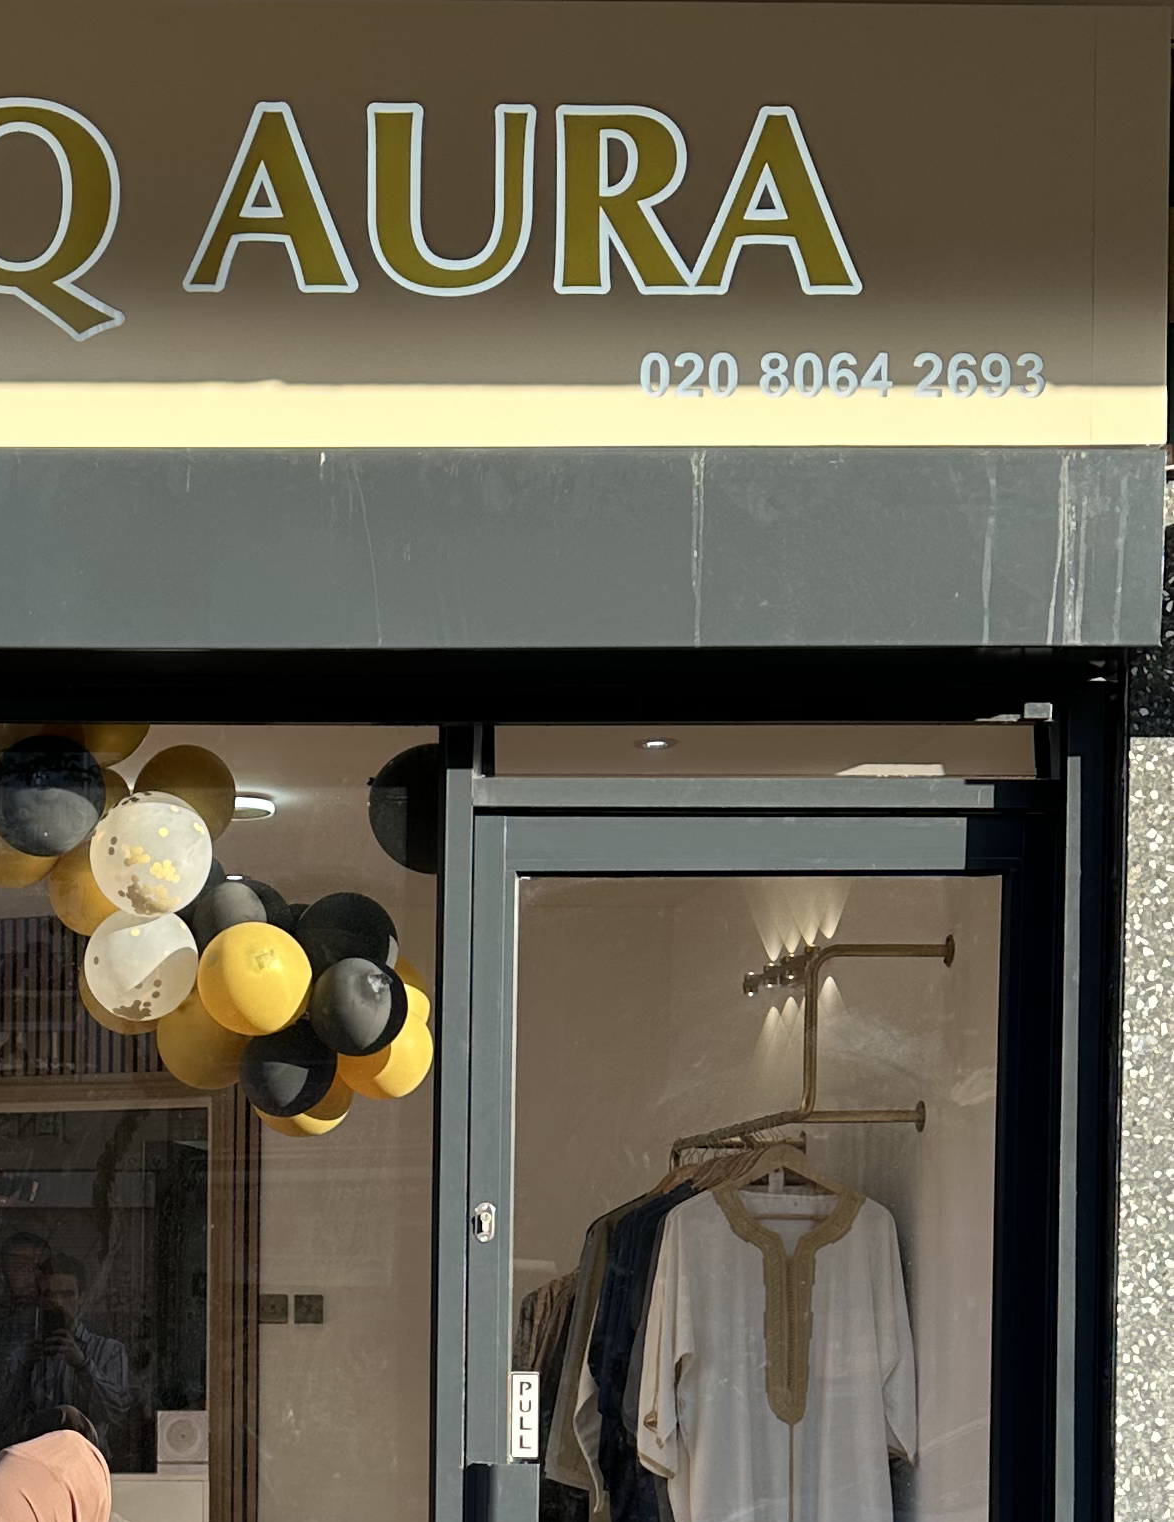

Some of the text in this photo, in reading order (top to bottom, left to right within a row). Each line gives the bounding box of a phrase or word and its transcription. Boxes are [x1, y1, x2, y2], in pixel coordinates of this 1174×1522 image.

[183, 101, 863, 297] AURA
[640, 352, 1046, 398] 020 8064 2693
[519, 1381, 532, 1449] PULL
